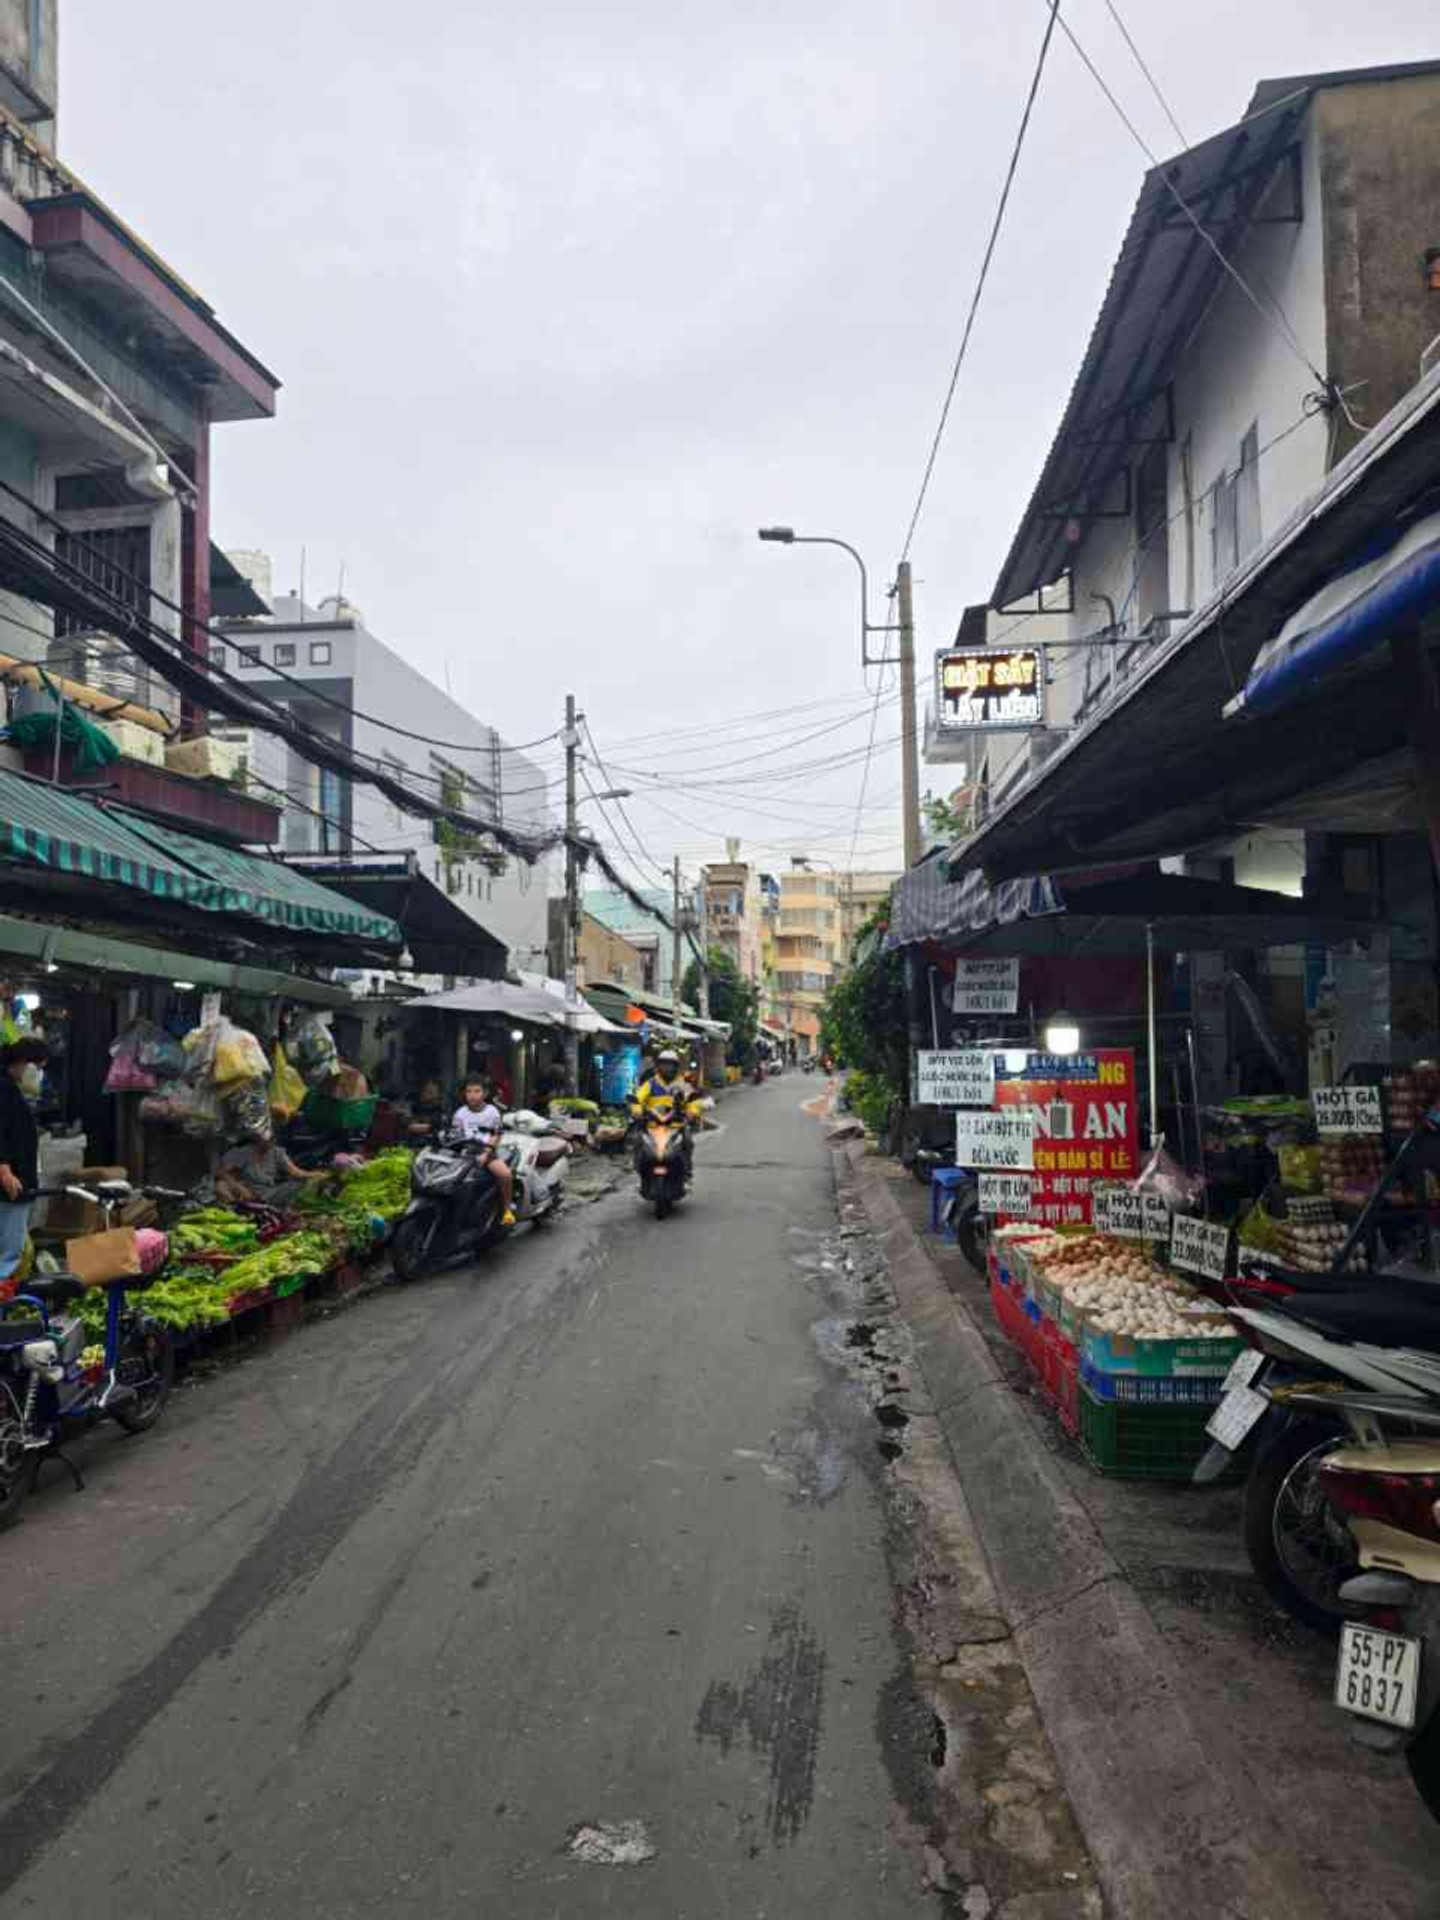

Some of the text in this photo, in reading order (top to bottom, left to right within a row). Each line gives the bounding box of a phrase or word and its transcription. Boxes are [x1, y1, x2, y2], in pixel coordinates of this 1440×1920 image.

[1316, 1090, 1351, 1106] HỘT
[1083, 1103, 1127, 1139] AN
[1111, 1191, 1167, 1211] HỘT GÀ
[1351, 1632, 1405, 1676] 55-P7
[1346, 1670, 1403, 1717] 6837
